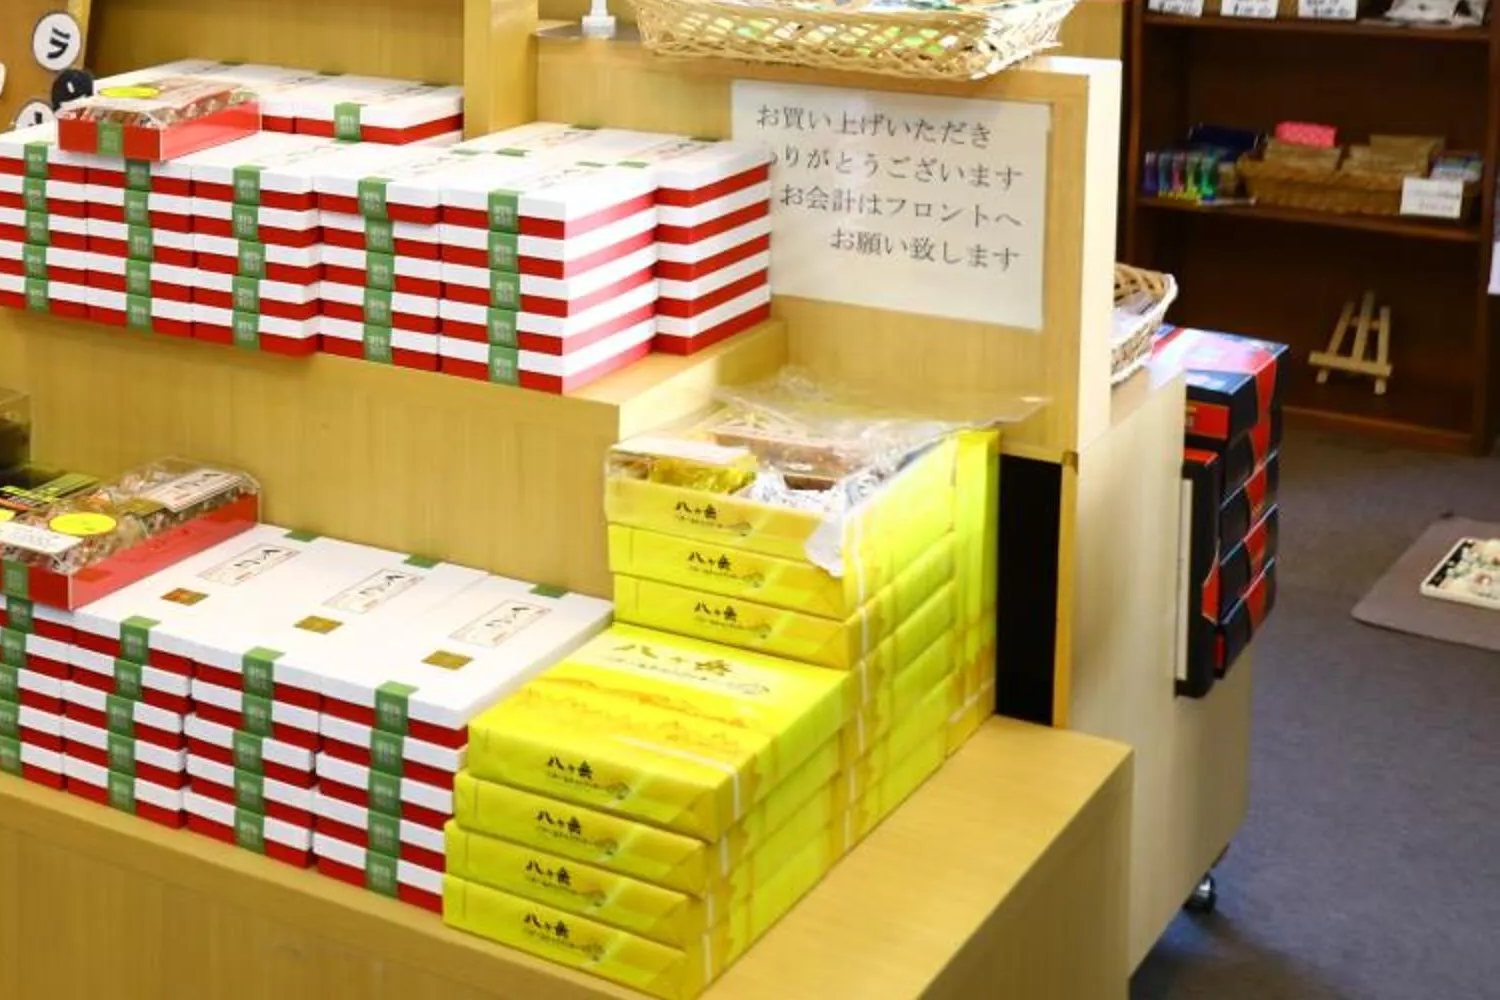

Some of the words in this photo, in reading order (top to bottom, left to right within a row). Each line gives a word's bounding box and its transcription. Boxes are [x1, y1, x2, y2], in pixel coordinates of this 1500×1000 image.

[756, 104, 992, 149] お買い上げいただき
[779, 185, 1023, 230] お会計はフロントへ
[829, 228, 1021, 272] お願い致します
